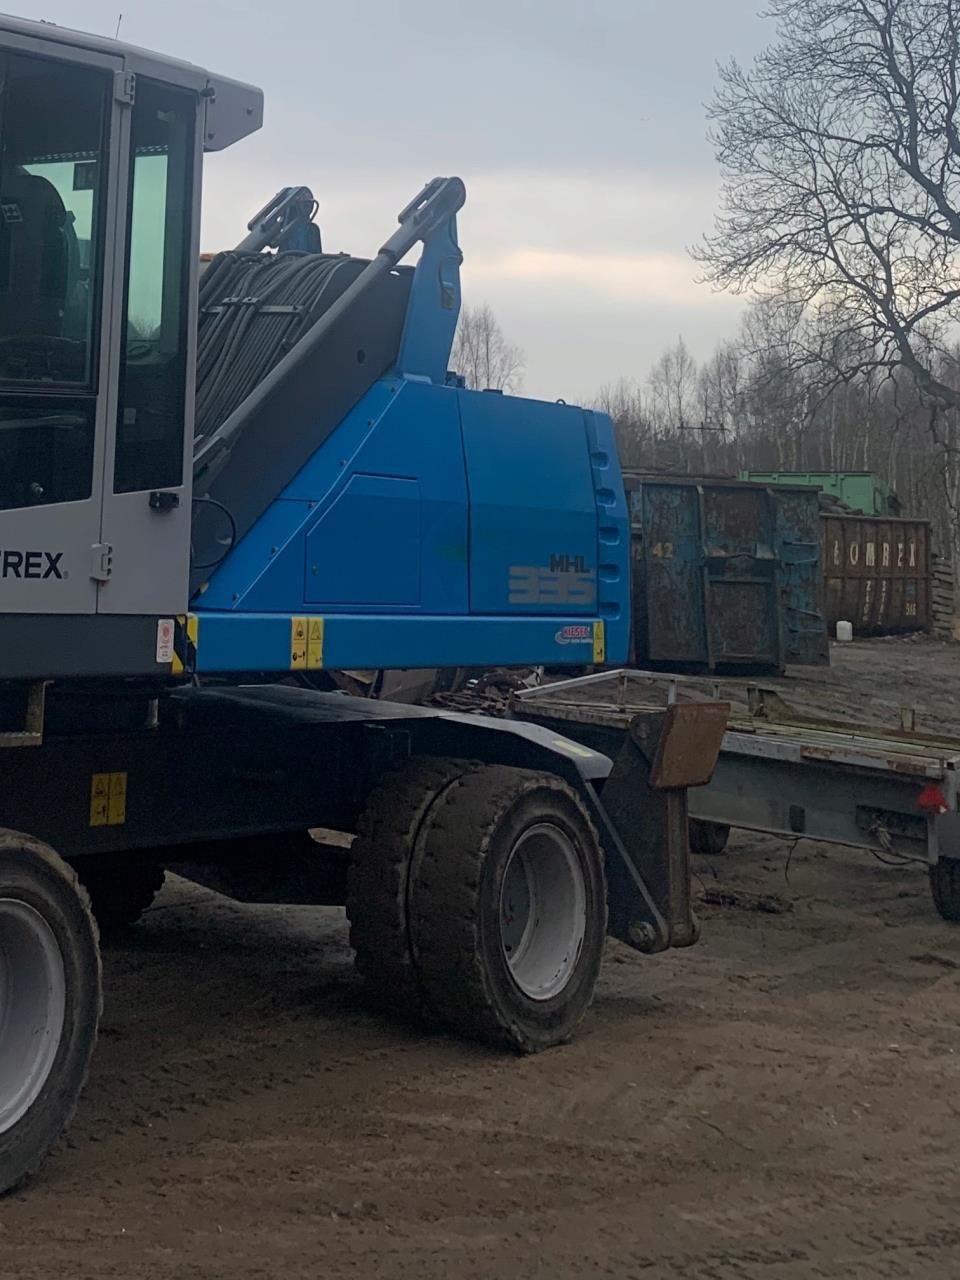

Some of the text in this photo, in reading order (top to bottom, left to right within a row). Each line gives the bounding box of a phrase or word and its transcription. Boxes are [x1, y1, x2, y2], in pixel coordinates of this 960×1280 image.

[652, 542, 673, 558] 42
[550, 554, 591, 573] MHL
[509, 566, 596, 604] 335
